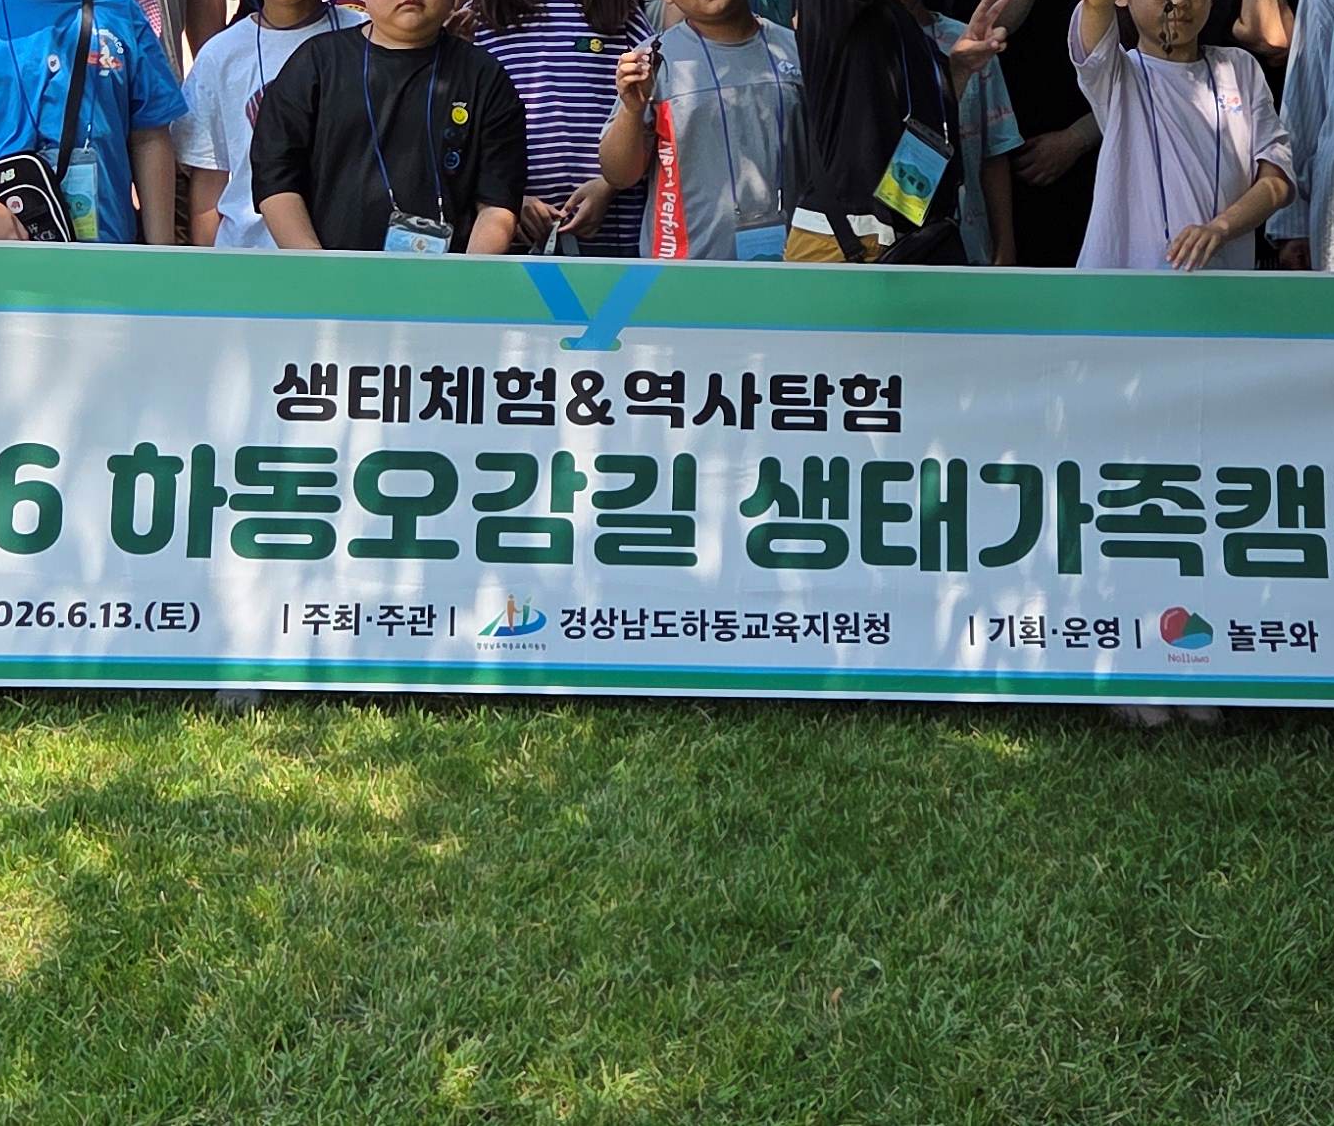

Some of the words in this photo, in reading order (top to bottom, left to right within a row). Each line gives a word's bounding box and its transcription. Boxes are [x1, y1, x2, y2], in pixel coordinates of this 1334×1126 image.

[273, 362, 903, 434] 생태체험&역사탐험
[107, 442, 698, 567] 하동오감길
[560, 606, 890, 645] 경상남도하동교육지원청
[1227, 619, 1319, 653] 놀루와
